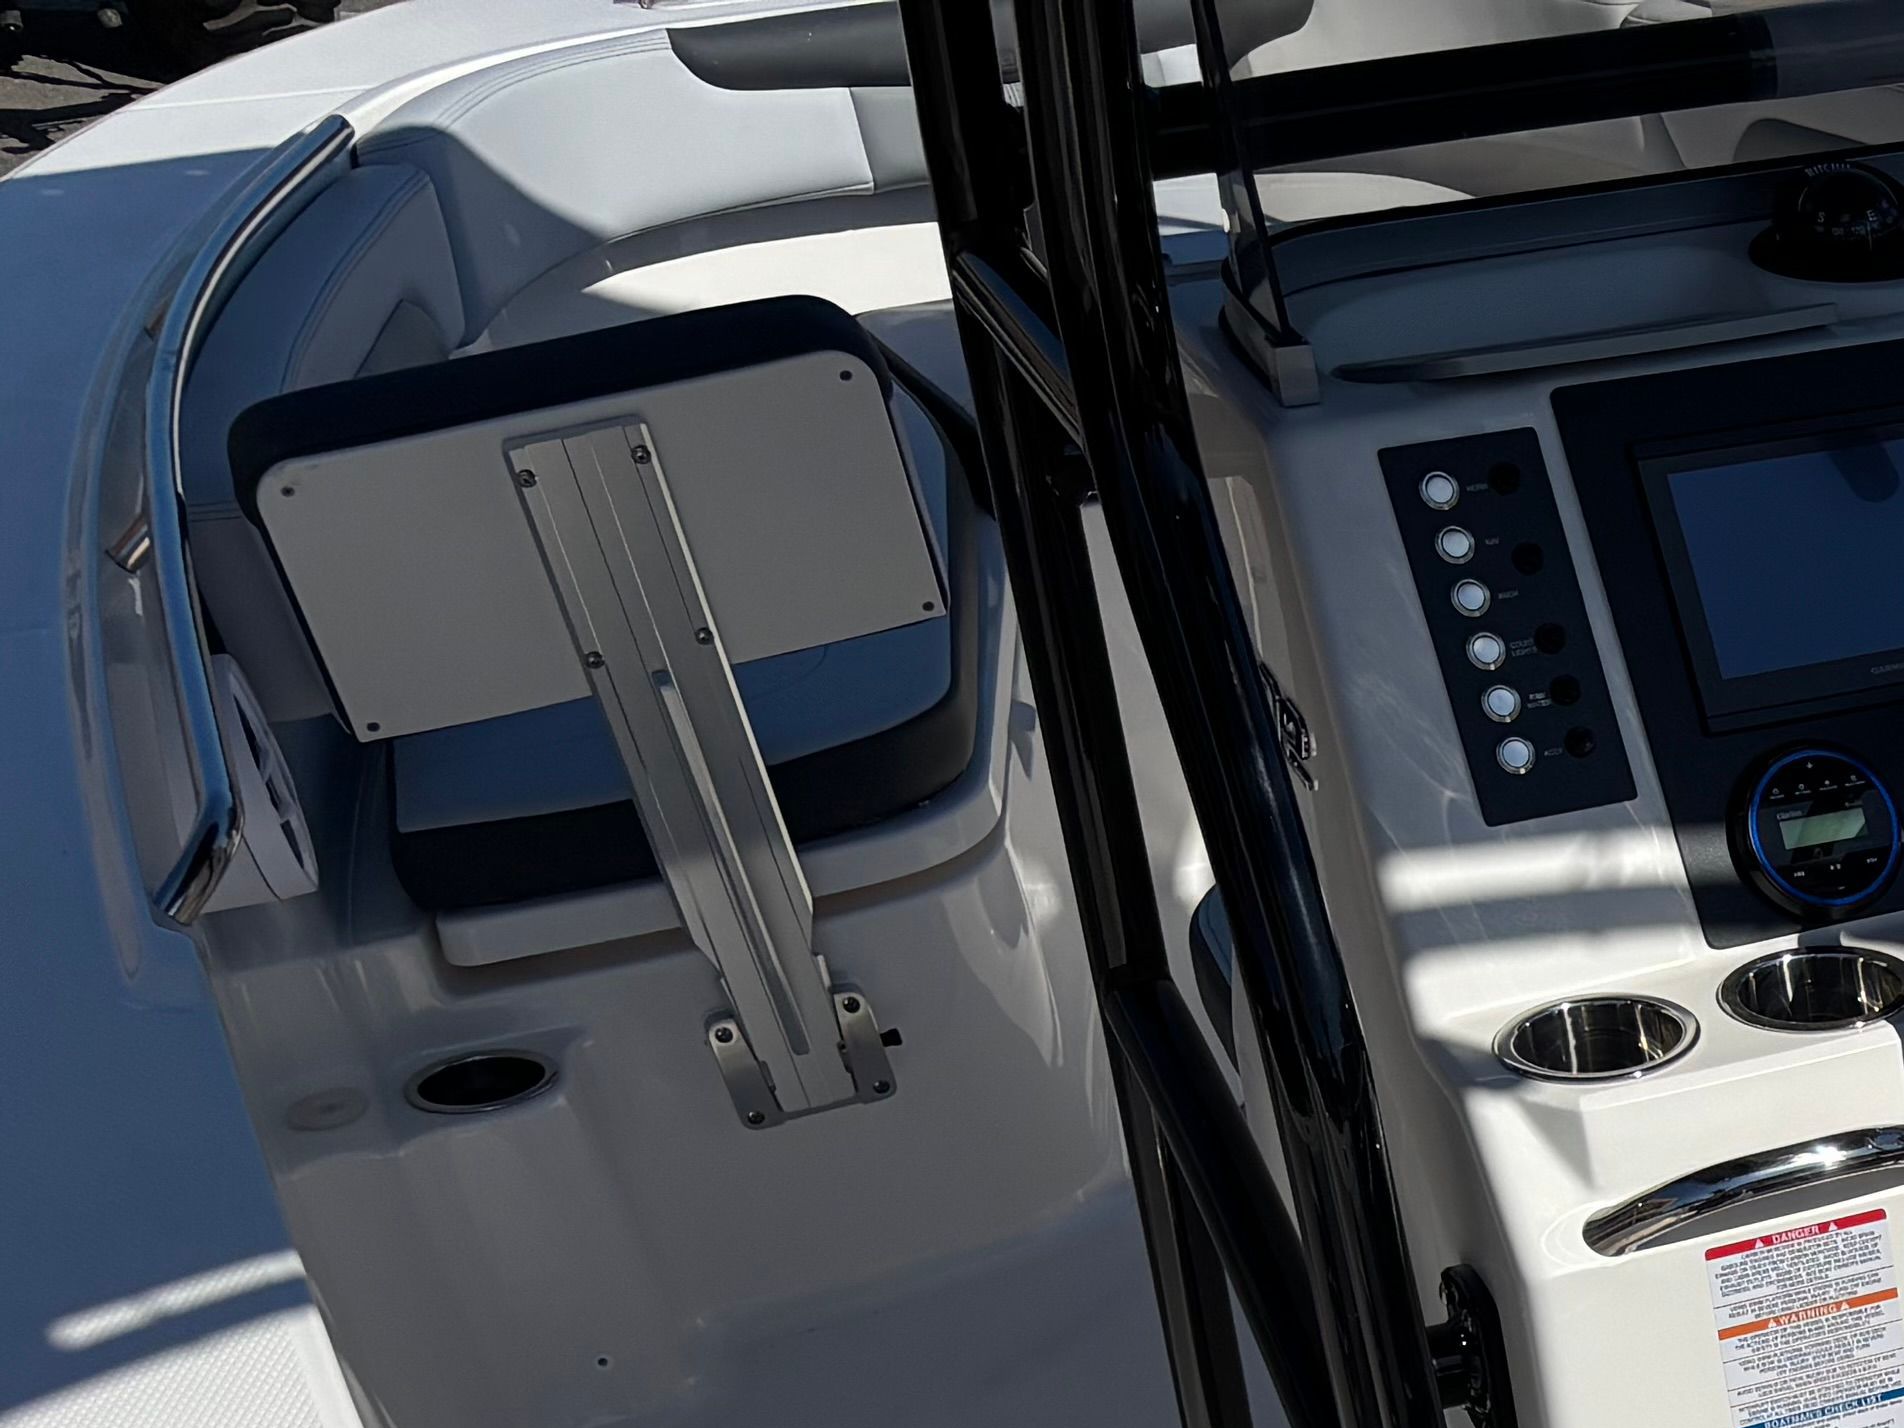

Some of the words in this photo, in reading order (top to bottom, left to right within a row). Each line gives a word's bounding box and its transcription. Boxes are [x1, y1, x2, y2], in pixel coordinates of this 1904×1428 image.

[1772, 1225, 1820, 1244] DANGER
[1778, 1304, 1838, 1326] WARNING
[1862, 1393, 1883, 1407] LIST
